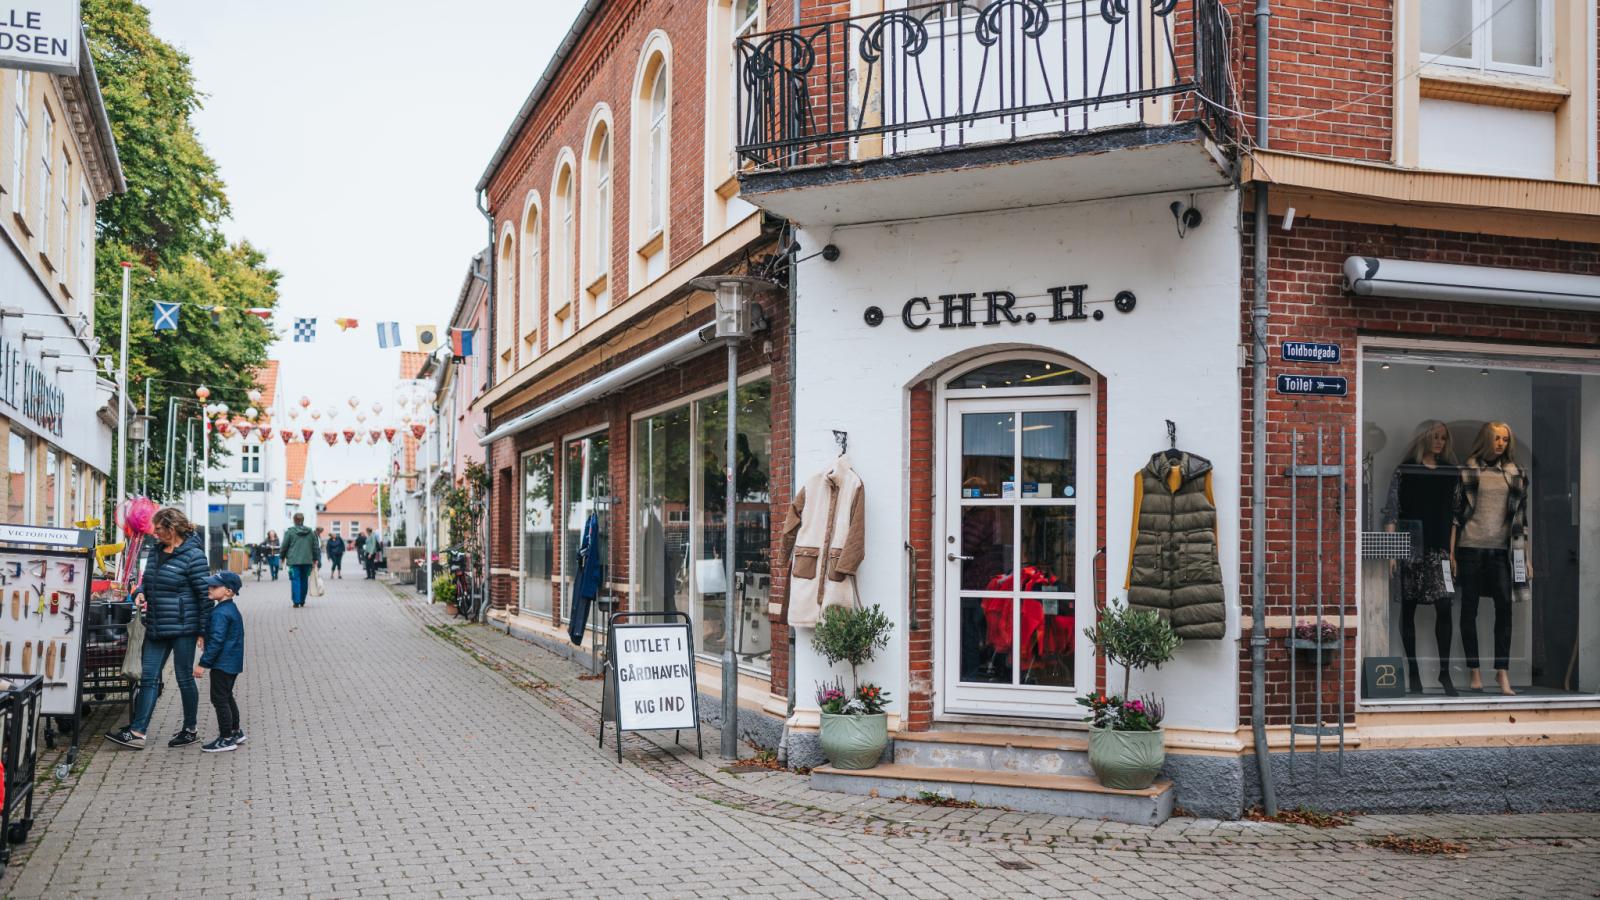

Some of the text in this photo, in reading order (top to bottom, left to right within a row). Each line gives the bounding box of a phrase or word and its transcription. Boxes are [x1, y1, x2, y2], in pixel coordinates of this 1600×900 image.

[901, 284, 1104, 330] CHR. H.
[1285, 343, 1336, 360] Toldbodgade
[1284, 377, 1313, 391] Toilet
[8, 530, 68, 539] VICTORINOX
[624, 637, 682, 653] OUTLET I
[620, 664, 689, 682] GÅRDHAVEN
[635, 696, 685, 715] KIG IND
